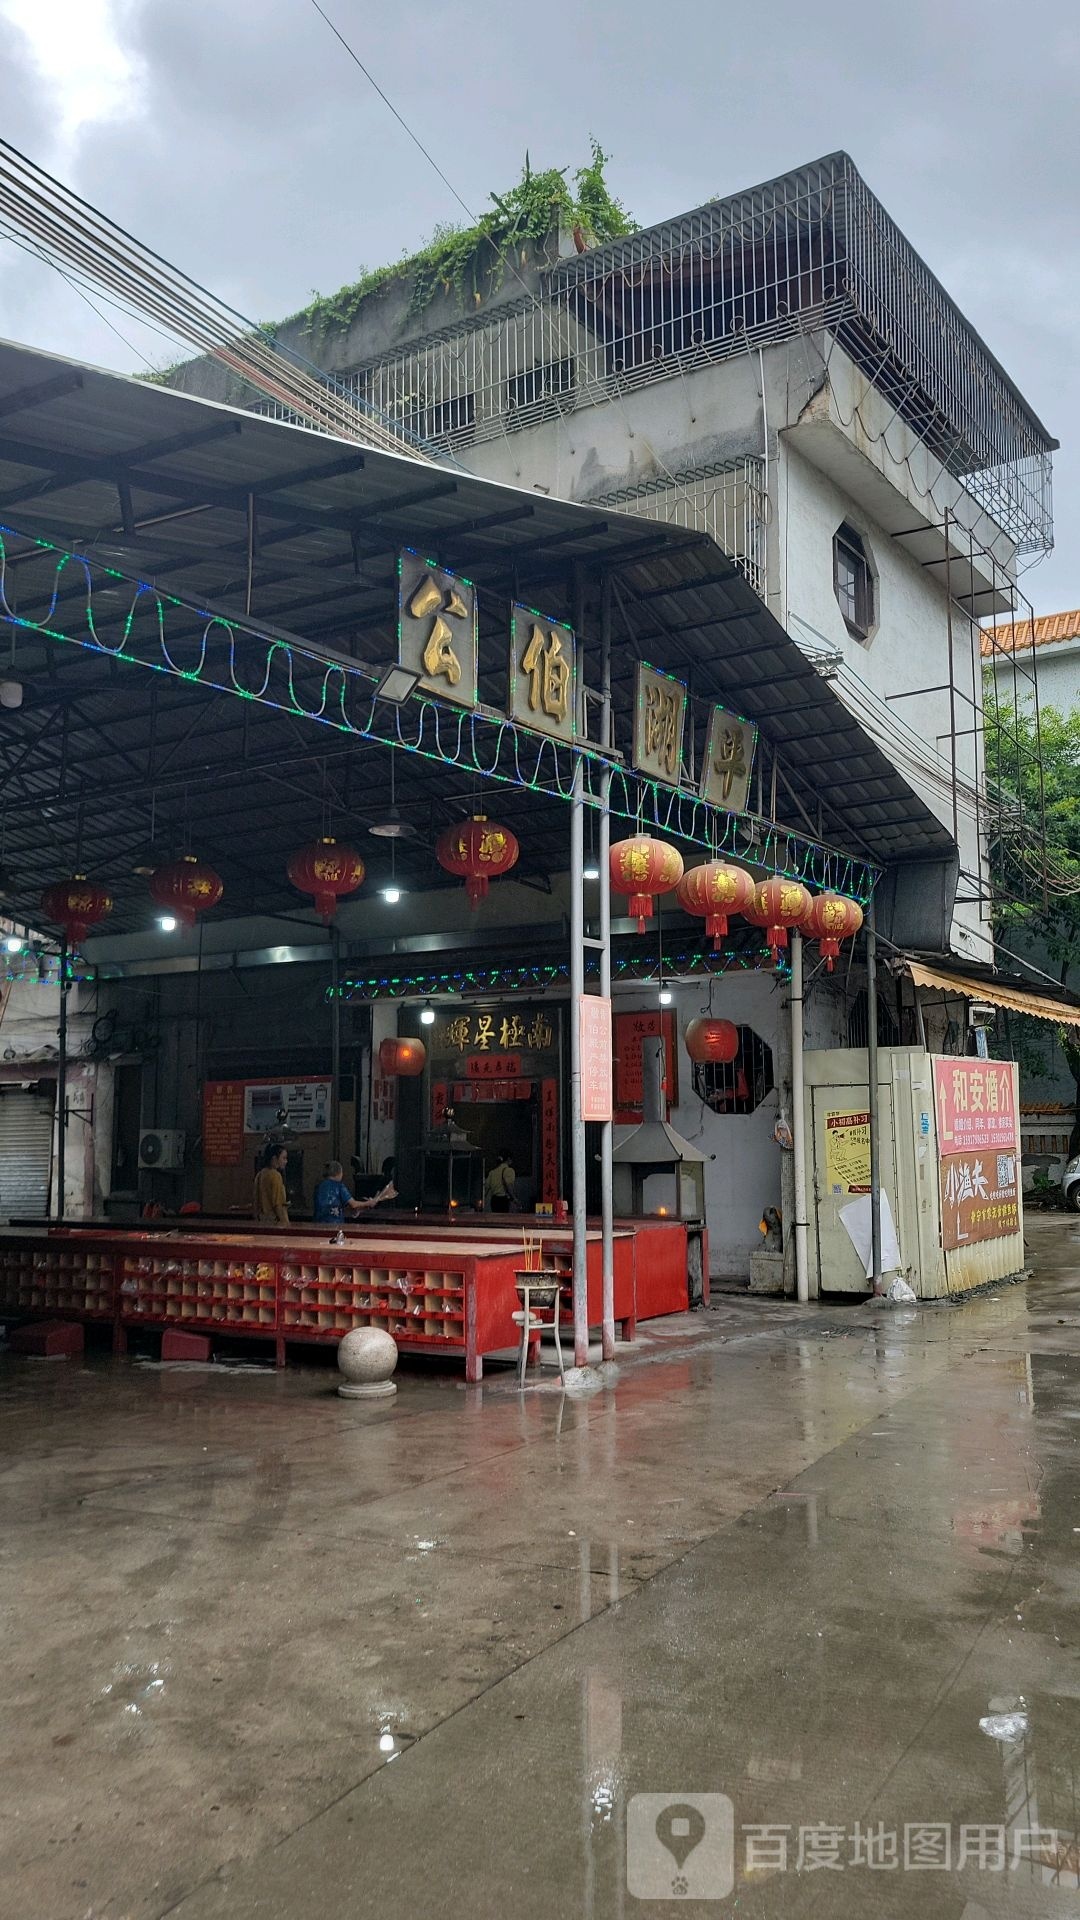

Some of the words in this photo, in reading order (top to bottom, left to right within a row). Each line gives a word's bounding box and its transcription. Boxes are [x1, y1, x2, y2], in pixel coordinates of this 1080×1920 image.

[952, 1069, 1010, 1113] 和安婚介
[830, 1114, 868, 1127] 小初高补习
